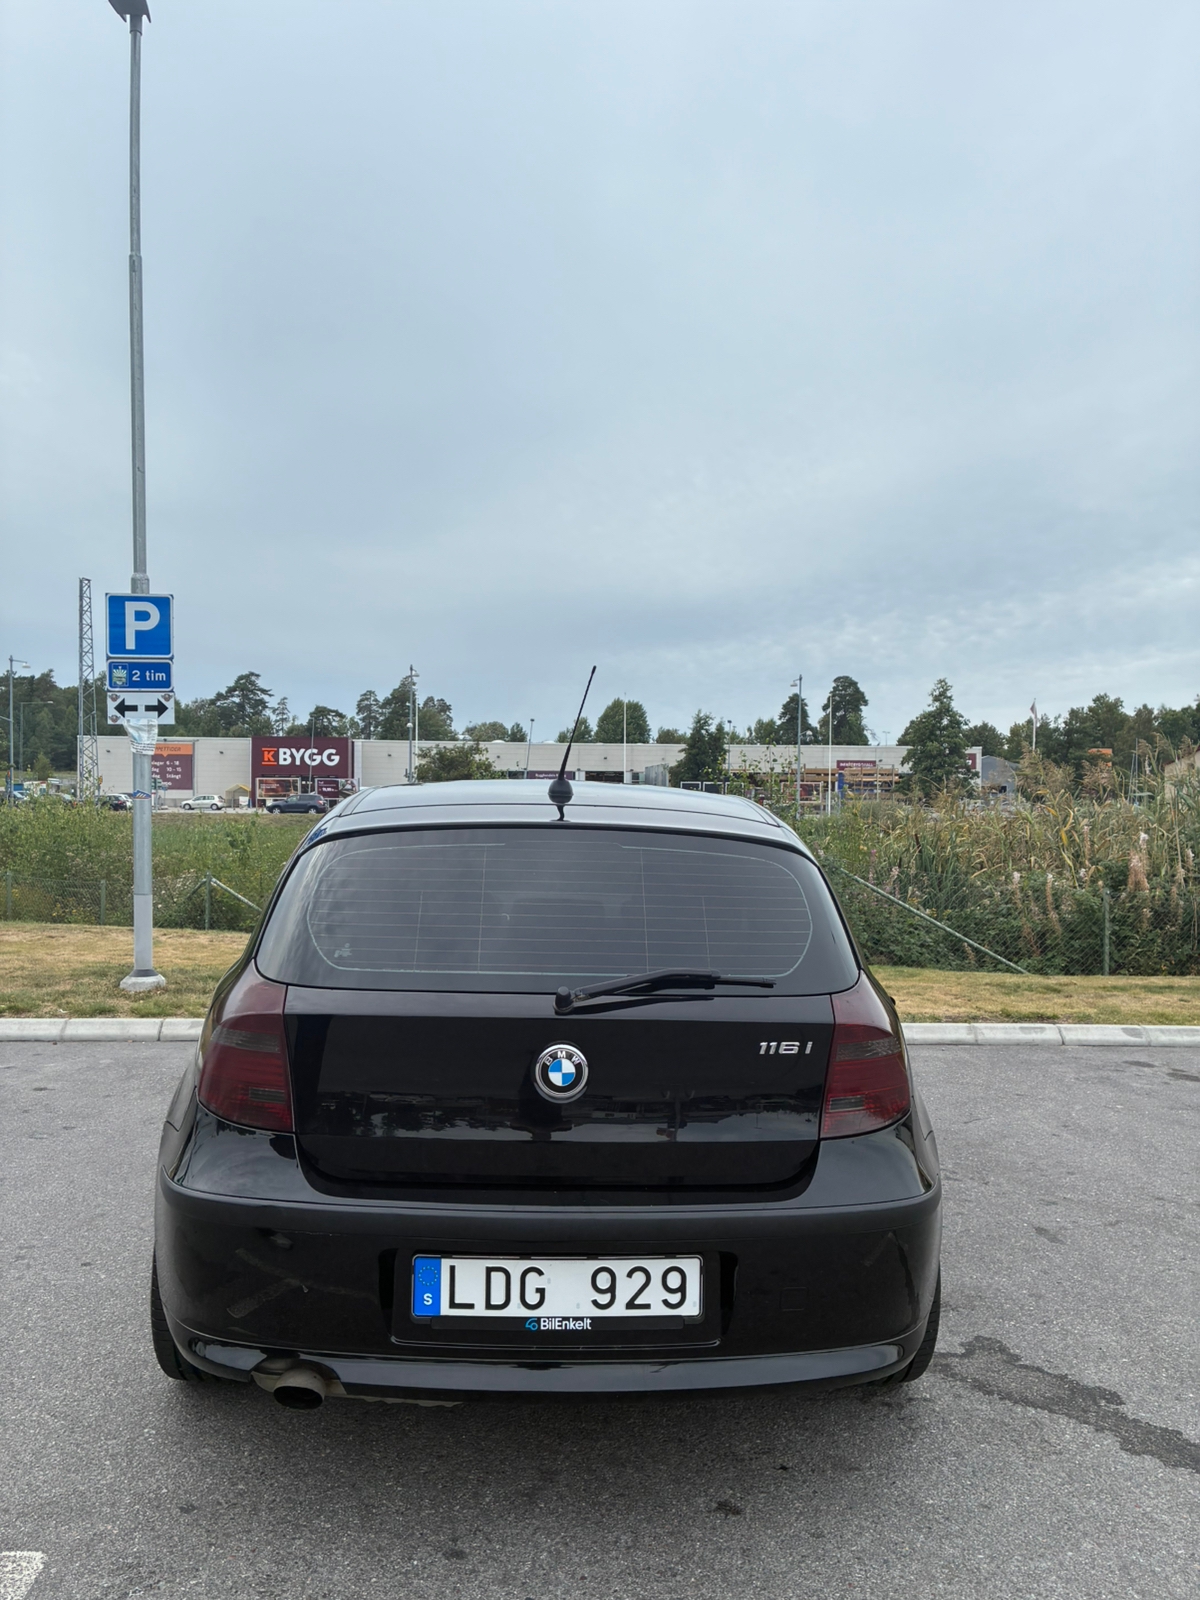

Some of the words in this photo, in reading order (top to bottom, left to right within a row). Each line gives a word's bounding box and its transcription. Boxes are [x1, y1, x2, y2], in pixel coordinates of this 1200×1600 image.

[124, 601, 161, 650] P
[131, 670, 141, 681] 2
[145, 670, 166, 681] tim
[278, 748, 340, 766] BYGG
[544, 1050, 581, 1066] BMW
[448, 1264, 546, 1310] LDG
[590, 1265, 687, 1310] 929
[423, 1293, 433, 1306] S
[540, 1318, 592, 1330] BilEnkelt
